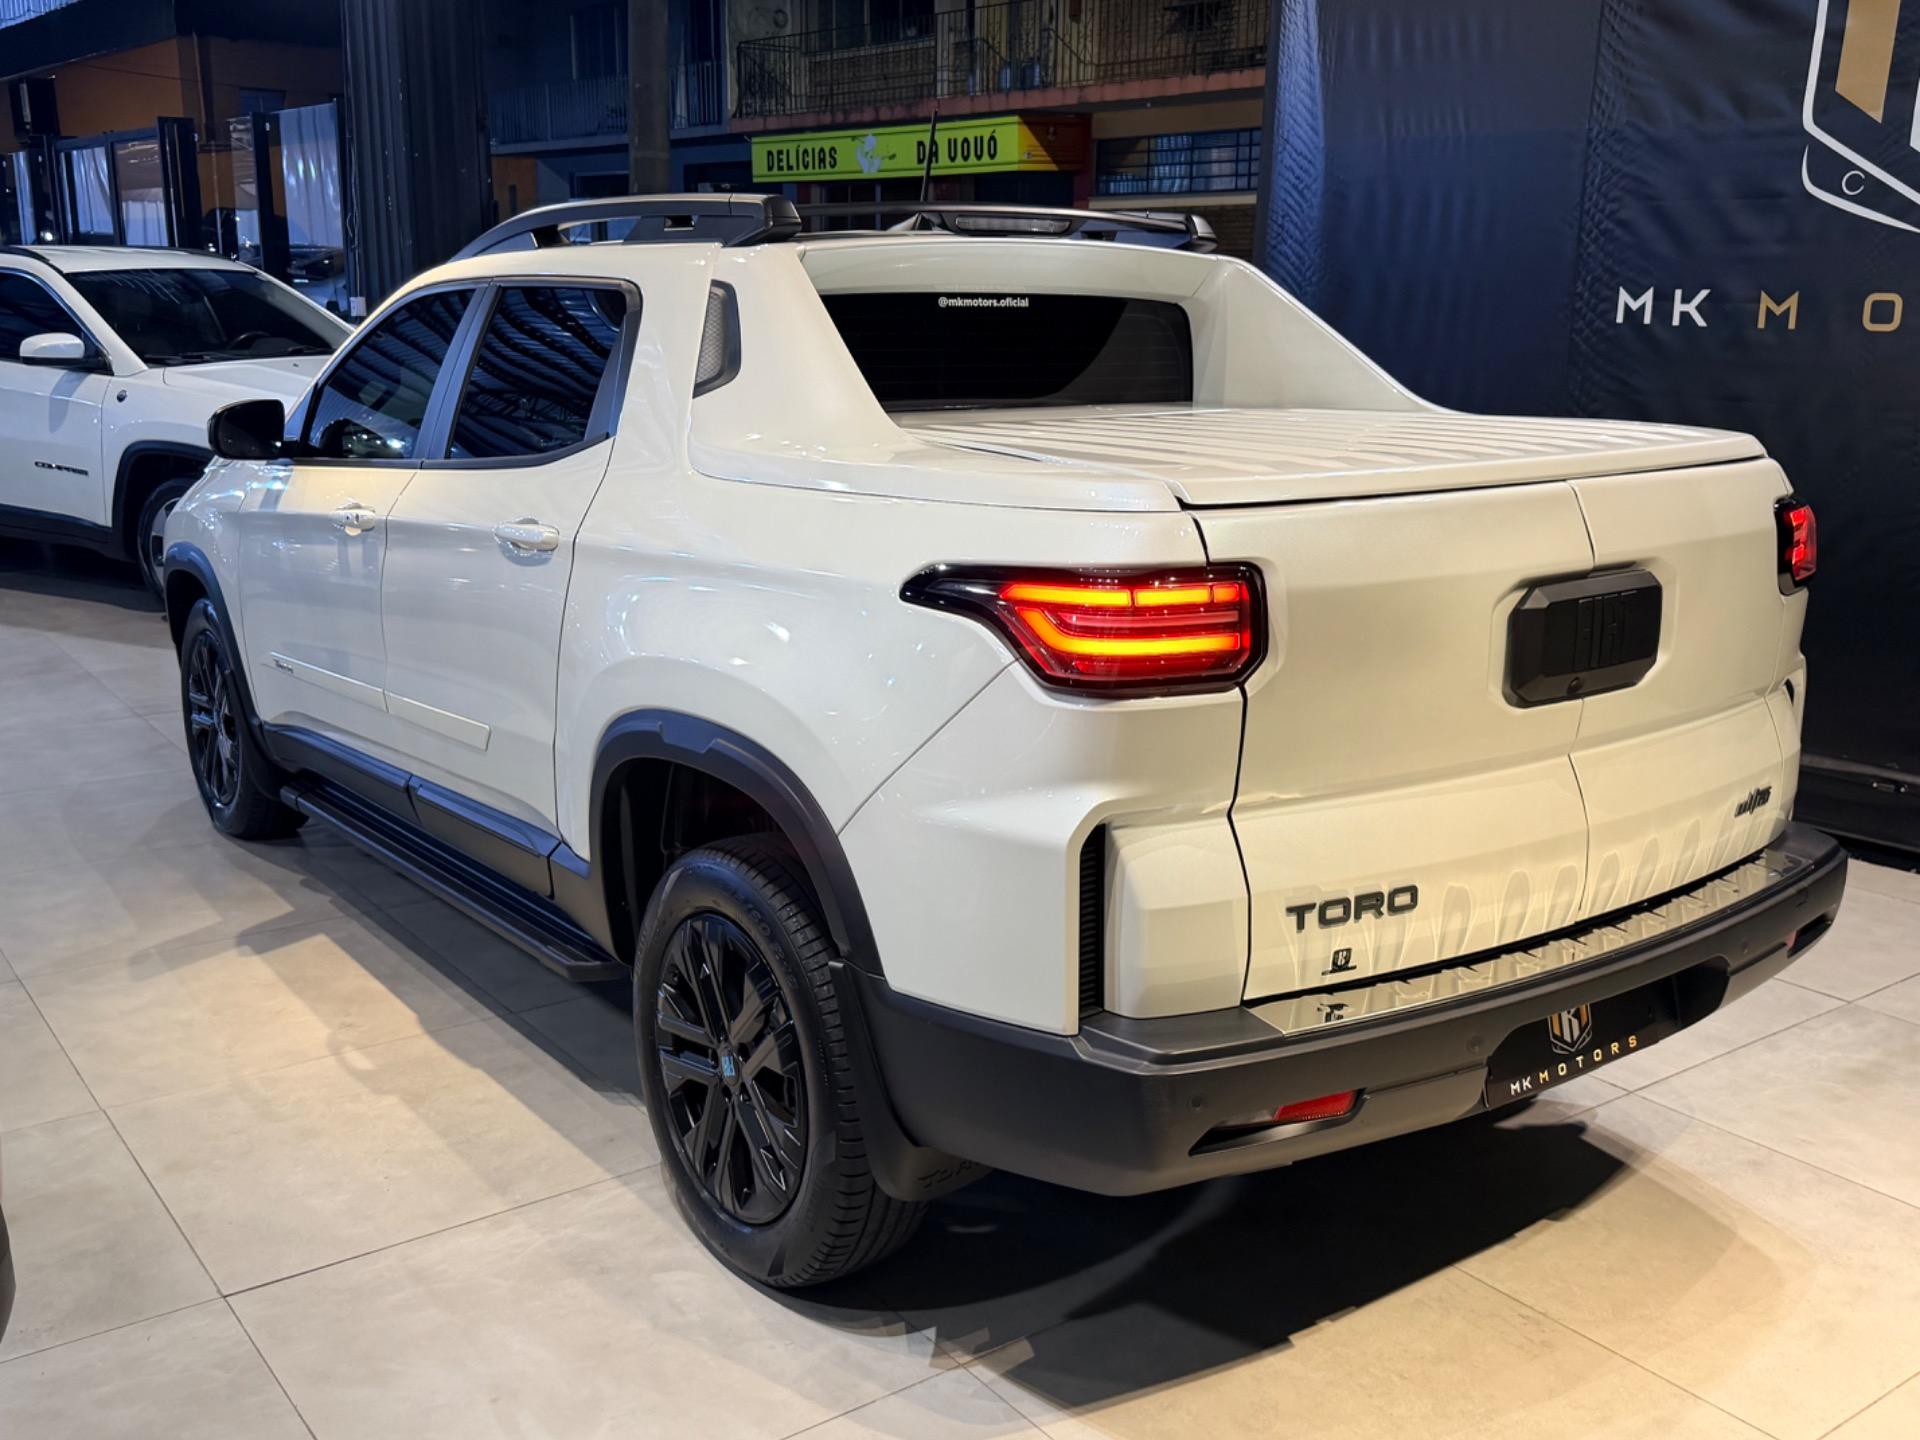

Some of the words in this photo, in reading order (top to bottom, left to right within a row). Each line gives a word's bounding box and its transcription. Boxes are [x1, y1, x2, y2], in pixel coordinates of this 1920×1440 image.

[767, 144, 837, 172] DELÍCIAS
[917, 138, 939, 165] DA
[938, 297, 1029, 308] @mkmotors.oficial
[1615, 286, 1711, 327] MK
[1286, 884, 1418, 933] TORO
[1510, 1075, 1533, 1096] MK
[1538, 1035, 1638, 1084] MOTORS
